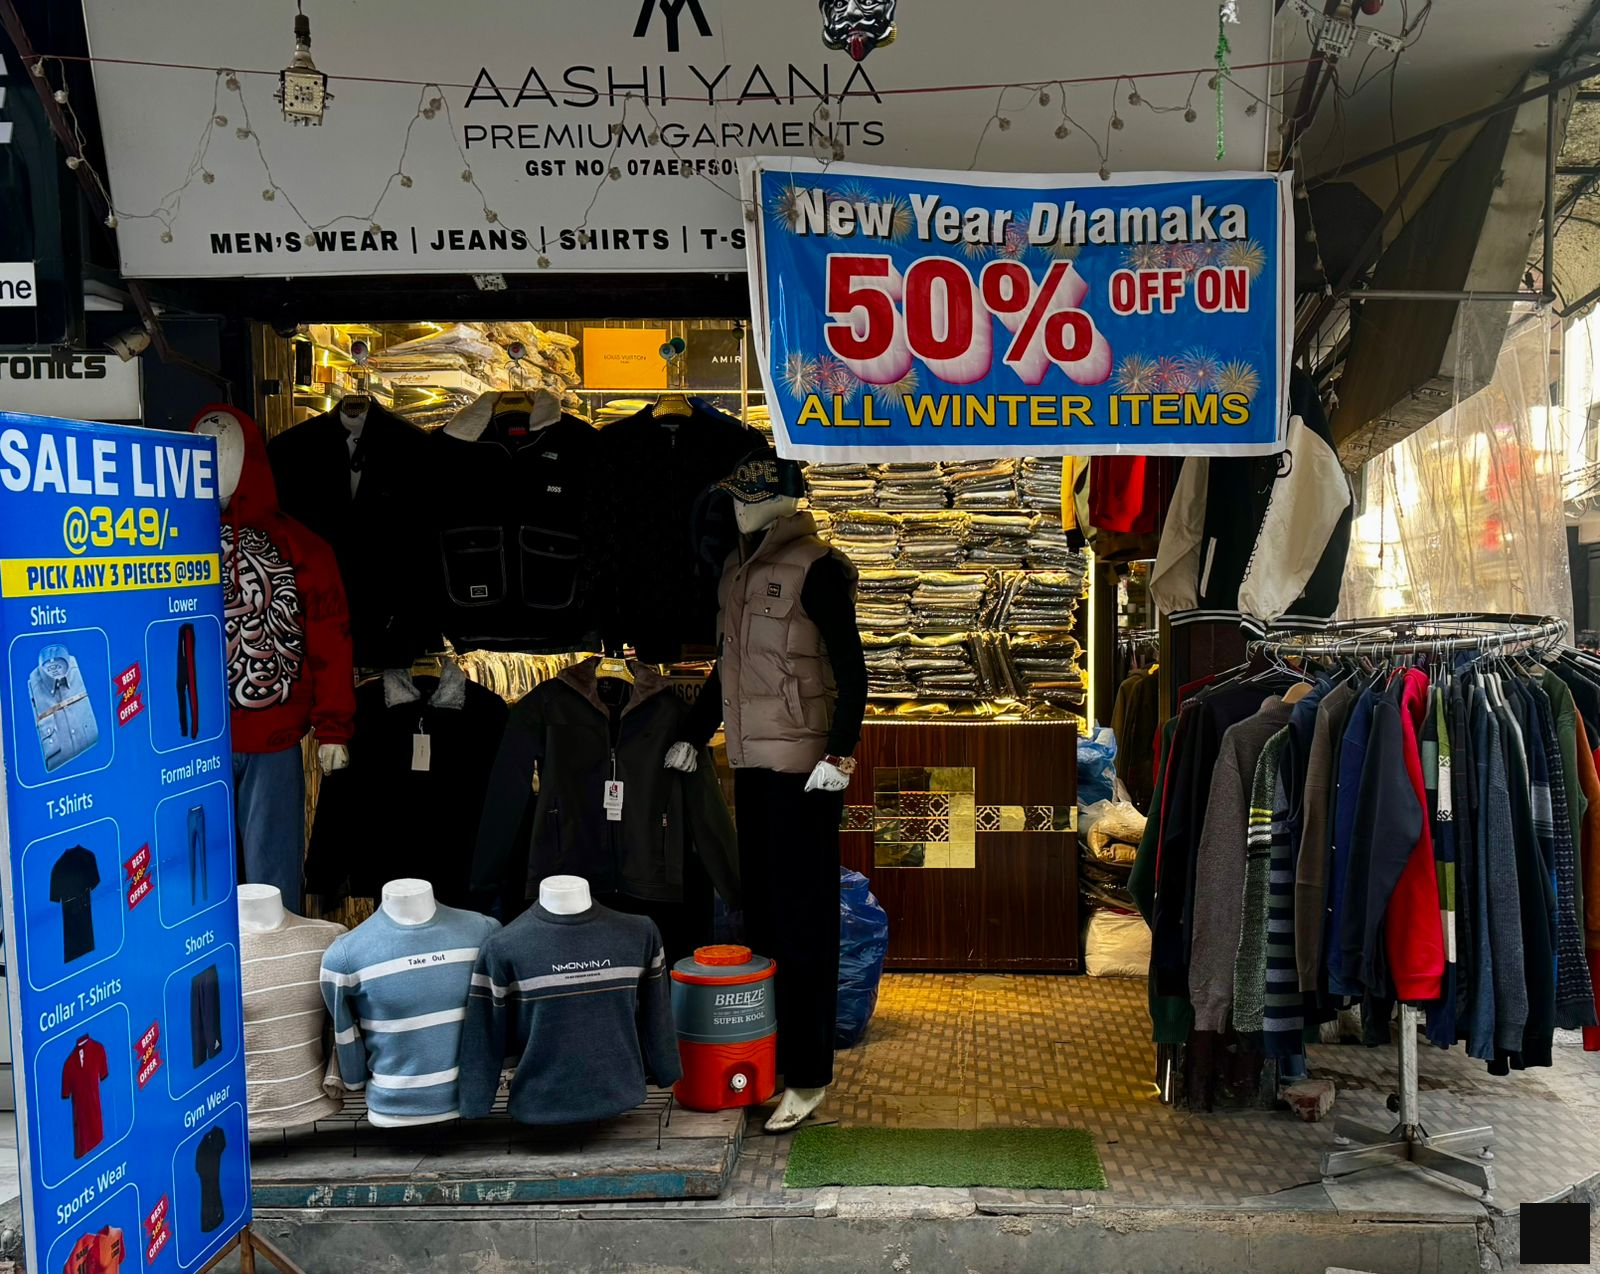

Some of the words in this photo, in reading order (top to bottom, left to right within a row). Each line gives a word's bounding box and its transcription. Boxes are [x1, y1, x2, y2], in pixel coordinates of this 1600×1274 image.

[464, 123, 649, 150] PREMIUM
[659, 121, 885, 148] GARMENTS
[525, 159, 566, 176] GST
[795, 187, 894, 237] New
[908, 193, 1011, 243] Year
[1027, 195, 1247, 246] Dhamaka
[210, 231, 302, 254] MEN'S
[312, 230, 400, 252] WEAR
[430, 229, 528, 251] JEANS
[559, 228, 669, 250] SHIRTS
[1108, 267, 1185, 315] OFF
[1195, 266, 1250, 314] ON
[823, 252, 1097, 368] 50%
[797, 393, 890, 427] ALL
[903, 393, 1095, 426] WINTER
[1108, 392, 1251, 426] ITEMS
[0, 428, 120, 497] SALE
[131, 442, 215, 499] LIVE
[63, 505, 178, 554] @349/-
[27, 564, 71, 590] PICK
[72, 563, 106, 588] ANY
[110, 563, 120, 586] 3
[123, 560, 171, 585] PIECES
[175, 559, 211, 582] @999
[30, 605, 67, 627] Shirts
[168, 596, 198, 613] Lower
[121, 667, 136, 686] BEST
[120, 700, 139, 721] OFFER
[161, 763, 194, 785] Formal
[195, 755, 221, 778] Pants
[46, 792, 94, 819] T-Shirts
[131, 849, 146, 869] BEST
[130, 881, 148, 904] OFFER
[185, 929, 215, 956] Shorts
[408, 957, 427, 966] Take
[432, 953, 446, 962] Out
[39, 1001, 76, 1033] Collar
[77, 976, 122, 1012] T-Shirts
[714, 987, 765, 1006] BREEZE
[713, 1016, 744, 1025] SUPER
[141, 1026, 155, 1049] BEST
[140, 1058, 157, 1083] OFFER
[184, 1099, 205, 1129] Gym
[207, 1084, 231, 1111] Wear
[56, 1184, 95, 1226] Sports
[98, 1160, 127, 1193] Wear
[151, 1199, 164, 1223] BEST
[149, 1230, 166, 1258] OFFER
